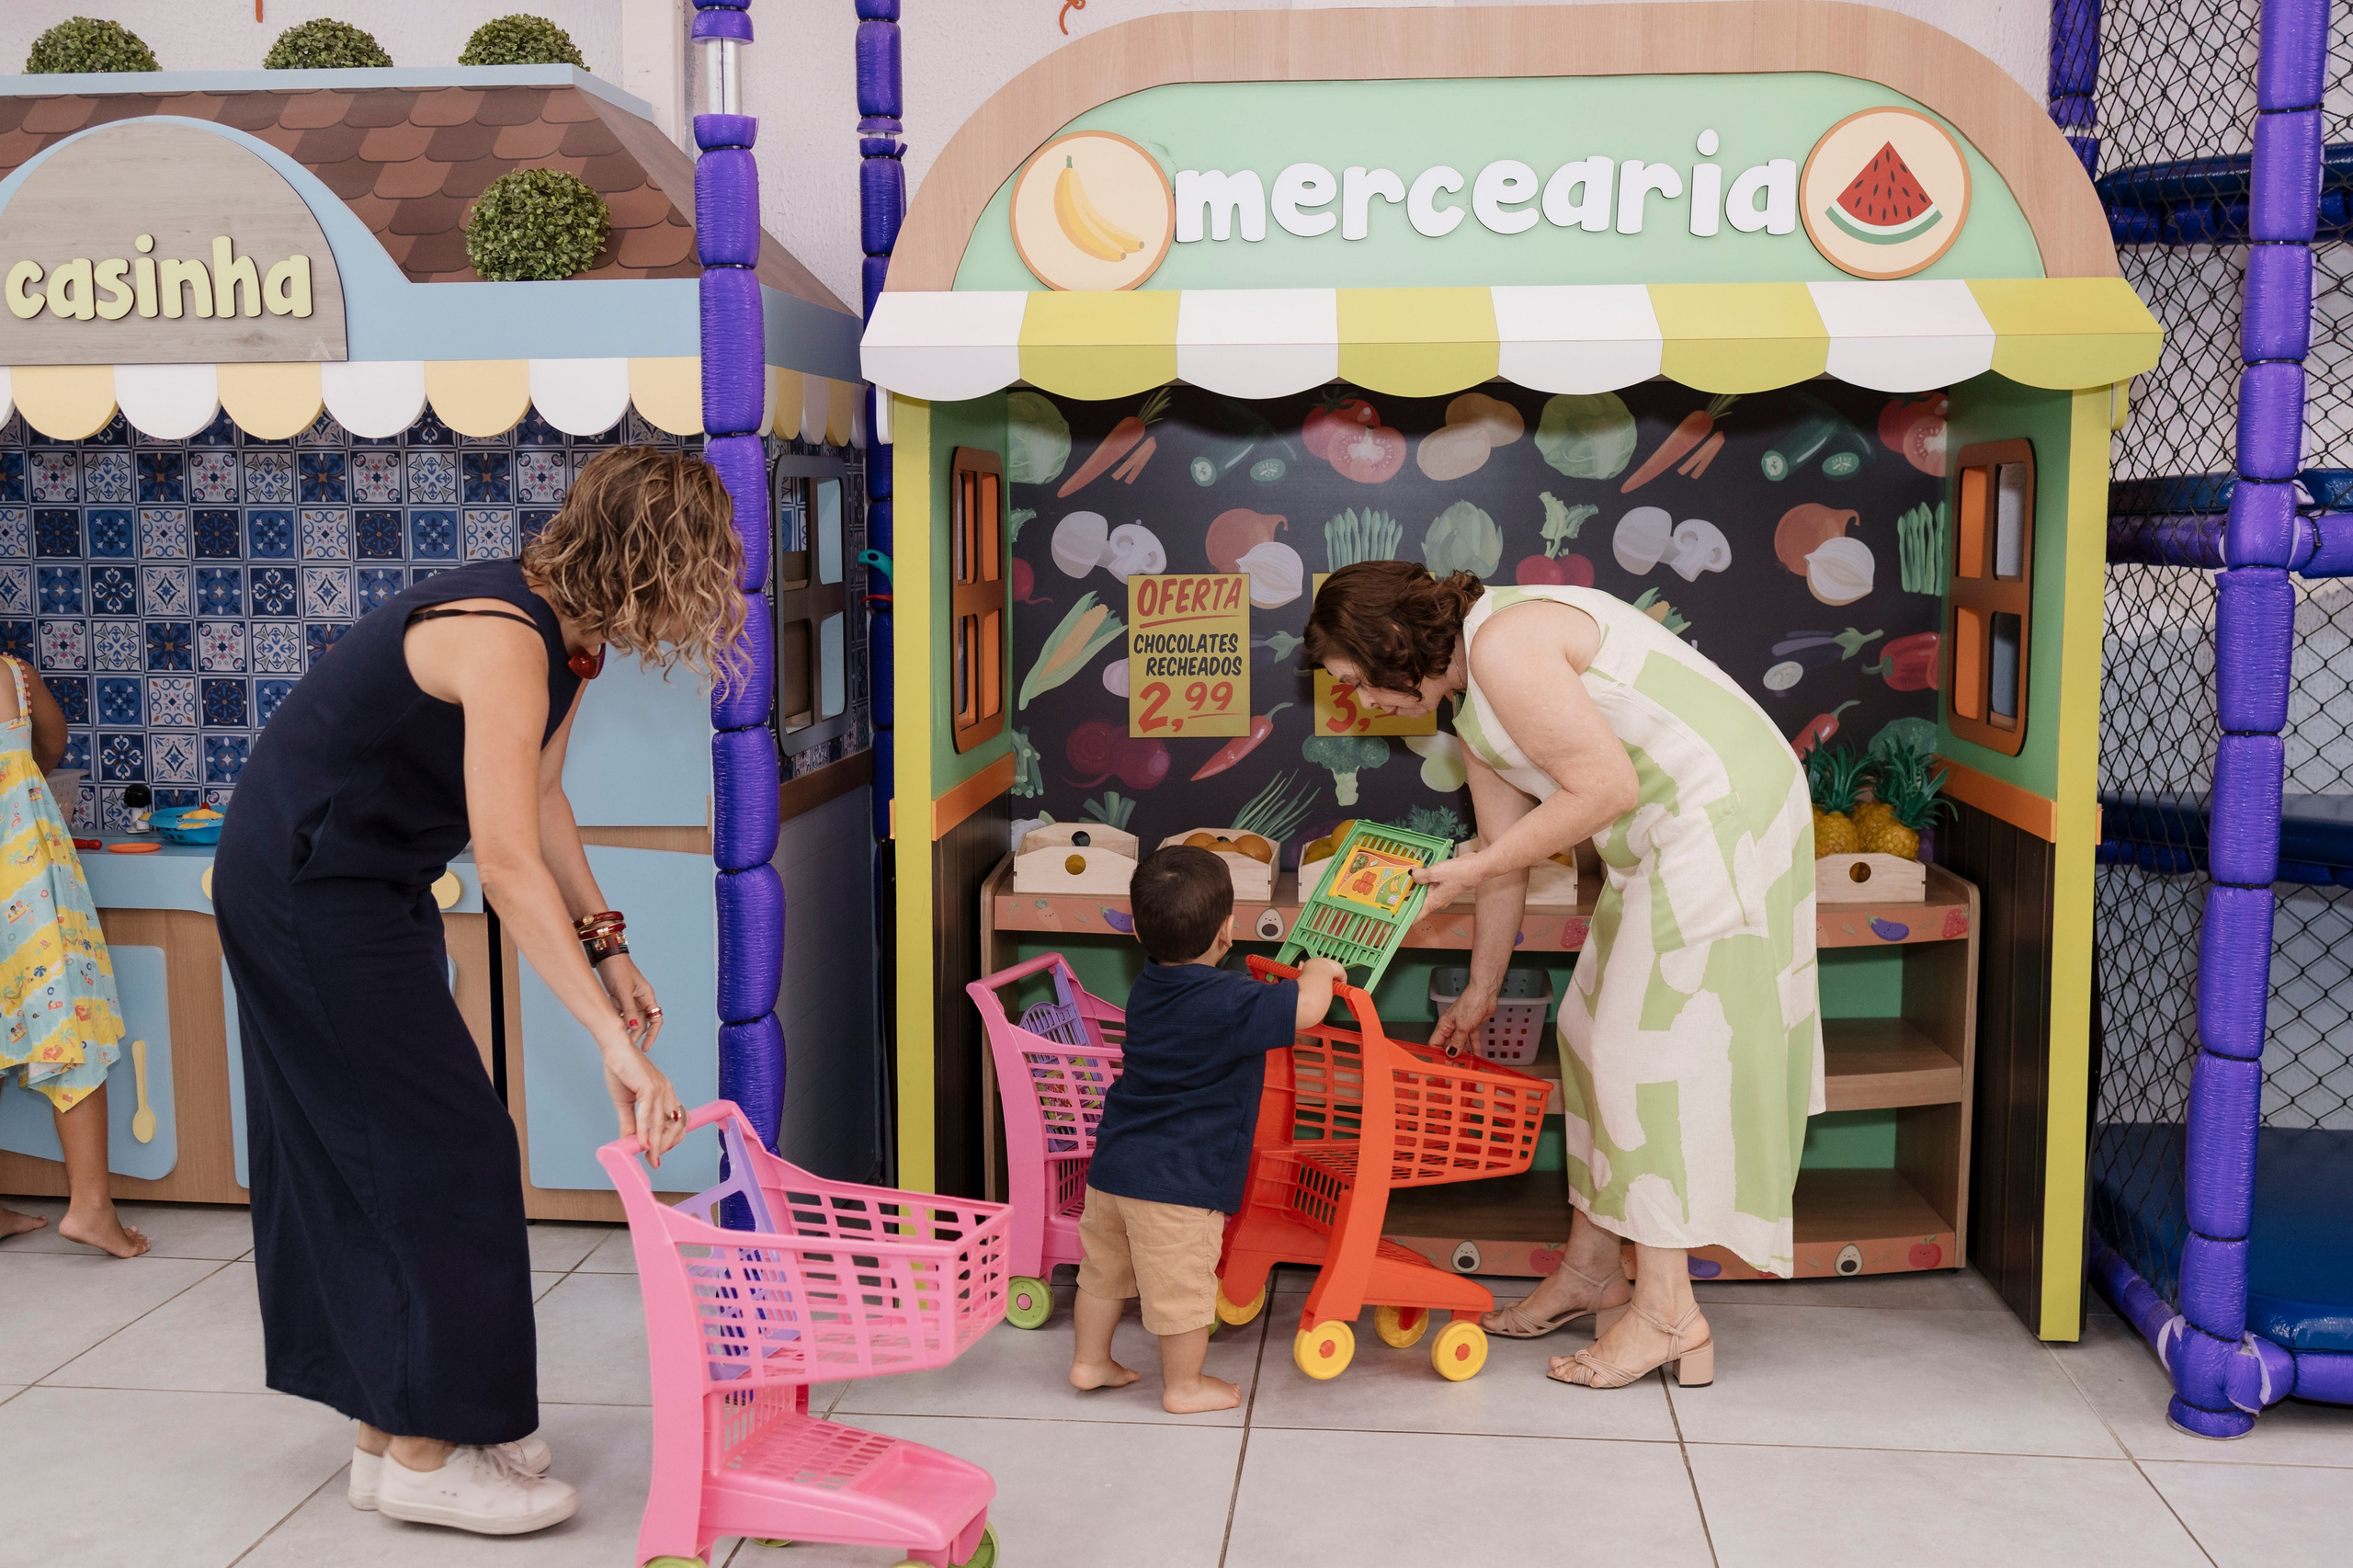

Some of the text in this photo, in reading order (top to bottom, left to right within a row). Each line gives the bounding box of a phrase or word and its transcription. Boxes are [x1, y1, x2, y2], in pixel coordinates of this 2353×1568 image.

[1174, 128, 1797, 243] mercearia
[5, 233, 314, 321] casinha
[1136, 577, 1243, 618] OFERTA
[1133, 633, 1239, 654] CHOCOLATES
[1145, 655, 1243, 676] RECHEADOS
[1137, 680, 1234, 733] 2,99
[1324, 683, 1383, 733] 3,
